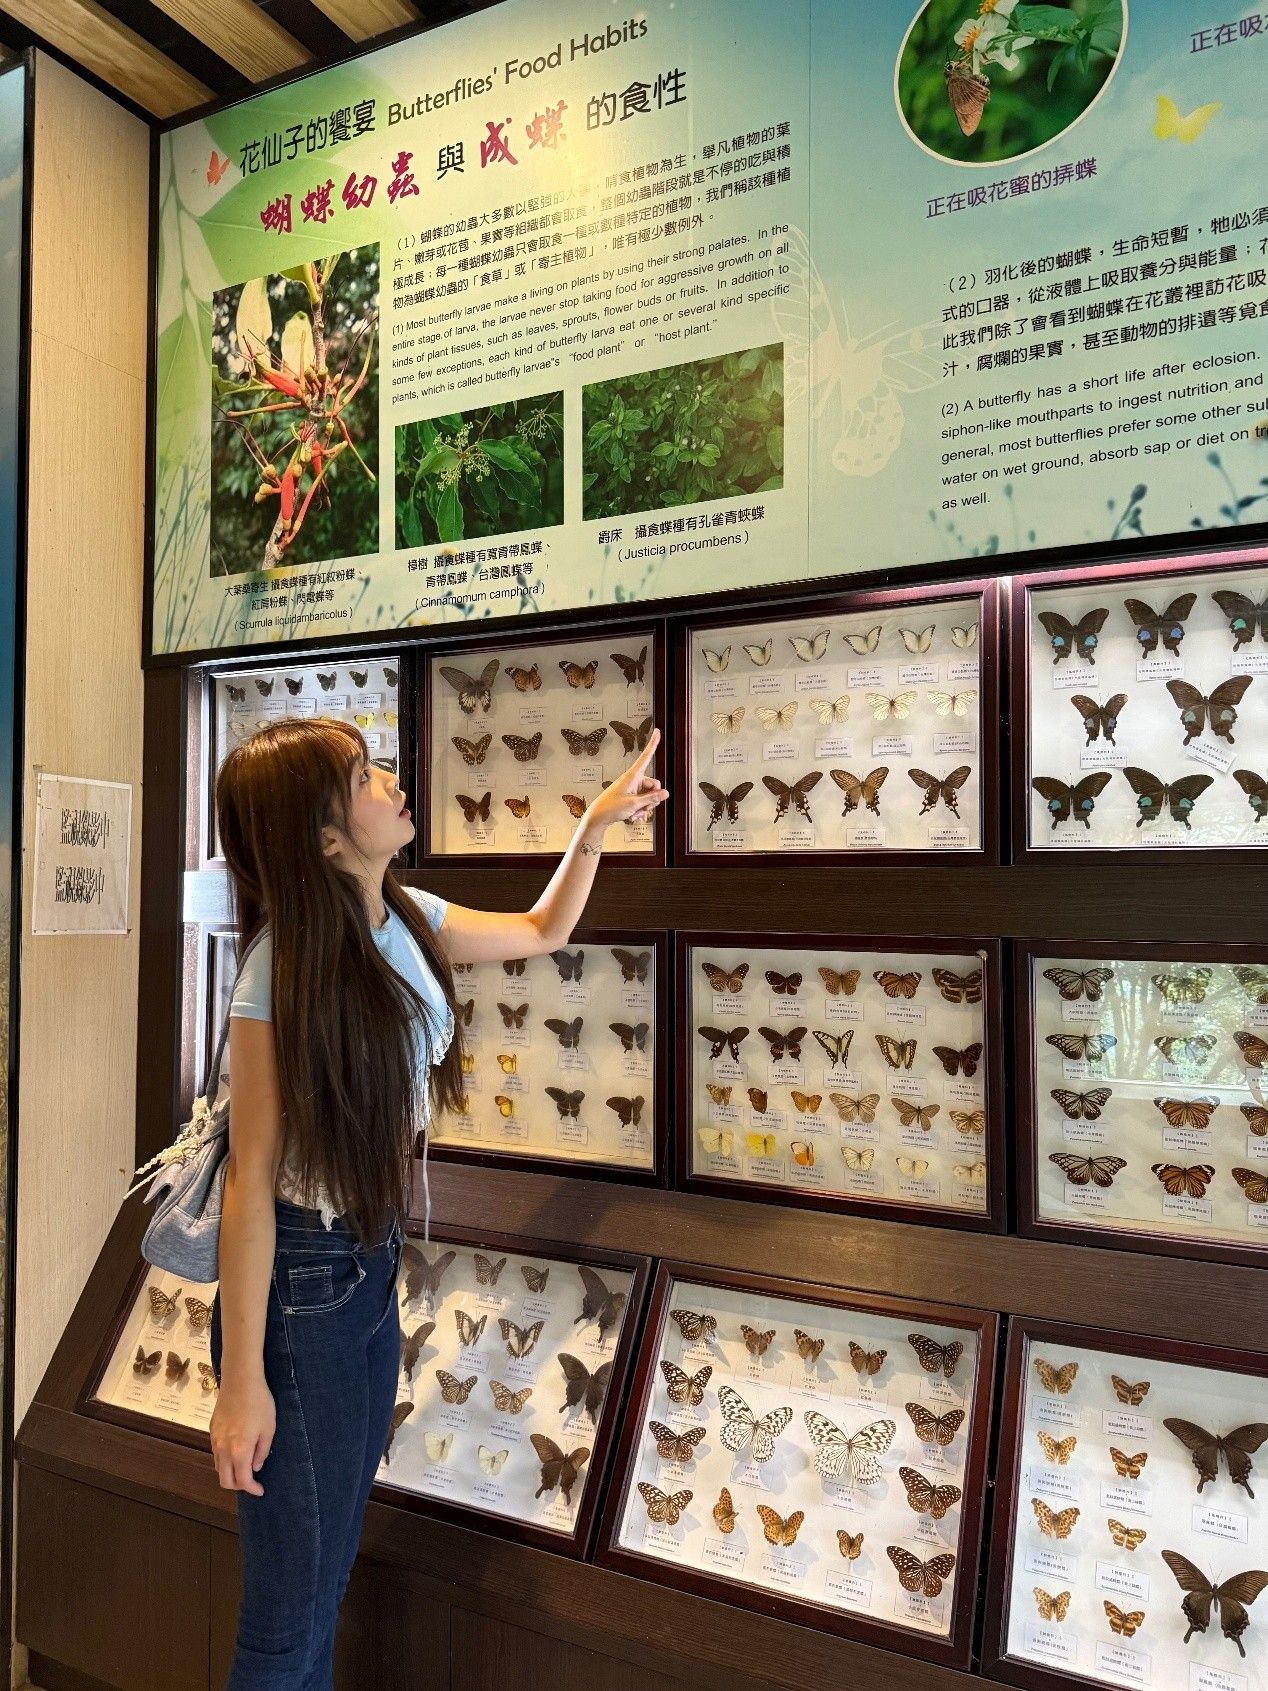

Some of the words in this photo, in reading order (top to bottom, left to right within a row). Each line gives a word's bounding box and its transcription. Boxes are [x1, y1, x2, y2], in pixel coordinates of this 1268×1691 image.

[1190, 14, 1268, 53] 正在吸
[239, 99, 376, 177] 花仙子的饗宴
[387, 67, 497, 126] Butterflies'
[505, 43, 562, 85] Food
[570, 16, 648, 61] Habits
[260, 151, 420, 236] 蝴蝶幼蟲
[437, 142, 465, 181] 與
[480, 100, 569, 169] 成蝶
[586, 67, 687, 131] 的食性
[392, 325, 403, 336] (1)
[406, 320, 426, 331] Most
[429, 309, 462, 324] butterfly
[465, 302, 491, 315] larvae
[494, 295, 518, 308] make
[530, 285, 553, 298] living
[557, 283, 567, 291] on
[571, 273, 600, 288] plants
[603, 268, 614, 280] by
[617, 262, 644, 276] using
[647, 255, 669, 268] their
[673, 247, 704, 262] strong
[709, 235, 750, 252] palates.
[758, 229, 767, 239] In
[772, 224, 789, 234] the
[392, 340, 415, 351] entire
[444, 329, 452, 338] of
[456, 324, 479, 336] larva,
[482, 319, 496, 328] the
[499, 312, 526, 324] larvae
[530, 304, 555, 316] never
[560, 298, 579, 311] stop
[583, 287, 612, 303] taking
[616, 281, 637, 295] food
[641, 278, 654, 287] for
[658, 264, 714, 284] aggressive
[718, 253, 754, 271] growth
[759, 249, 771, 258] on
[777, 242, 789, 254] all
[392, 356, 413, 368] kinds
[417, 353, 424, 362] of
[427, 347, 448, 361] plant
[451, 340, 484, 355] tissues,
[487, 331, 508, 345] such
[511, 330, 522, 339] as
[526, 321, 558, 335] leaves,
[562, 312, 600, 328] sprouts,
[604, 304, 632, 317] flower
[638, 296, 661, 308] buds
[666, 293, 675, 301] or
[681, 285, 708, 298] fruits.
[718, 279, 726, 289] In
[732, 267, 774, 286] addition
[779, 265, 789, 274] to
[392, 375, 414, 386] some
[418, 369, 432, 380] few
[436, 358, 484, 376] exceptions,
[489, 351, 510, 363] each
[514, 345, 532, 357] kind
[537, 342, 546, 351] of
[550, 332, 587, 349] butterfly
[591, 327, 615, 339] larva
[620, 321, 635, 331] eat
[640, 317, 658, 327] one
[663, 313, 673, 321] or
[678, 301, 716, 319] several
[721, 295, 742, 308] kind
[748, 284, 790, 302] specific
[422, 384, 445, 396] which
[448, 382, 454, 390] is
[458, 376, 482, 388] called
[485, 366, 520, 382] butterfly
[634, 339, 645, 348] or
[941, 403, 959, 416] (2)
[964, 400, 974, 411] A
[978, 390, 1031, 410] butterfly
[1037, 385, 1062, 398] has
[1069, 383, 1076, 393] a
[1083, 374, 1118, 389] short
[1125, 368, 1145, 383] life
[1152, 364, 1186, 378] after
[1193, 350, 1261, 371] eclosion.
[941, 417, 1011, 440] siphon-like
[1017, 403, 1094, 426] mouthparts
[1100, 400, 1113, 412] to
[1118, 391, 1162, 410] ingest
[1168, 380, 1228, 400] nutrition
[1235, 374, 1263, 389] and
[941, 444, 994, 464] general,
[999, 439, 1031, 452] most
[1036, 426, 1103, 447] butterflies
[1108, 417, 1150, 437] prefer
[1156, 412, 1196, 427] some
[1202, 403, 1241, 420] other
[942, 471, 978, 486] water
[982, 469, 998, 480] on
[1003, 463, 1028, 476] wet
[1032, 454, 1083, 474] ground,
[1089, 446, 1139, 463] absorb
[1144, 441, 1170, 456] sap
[1176, 439, 1191, 450] or
[1197, 432, 1224, 446] diet
[1230, 428, 1249, 441] on
[1255, 425, 1268, 437] tr
[942, 498, 957, 510] as
[962, 491, 990, 506] well.
